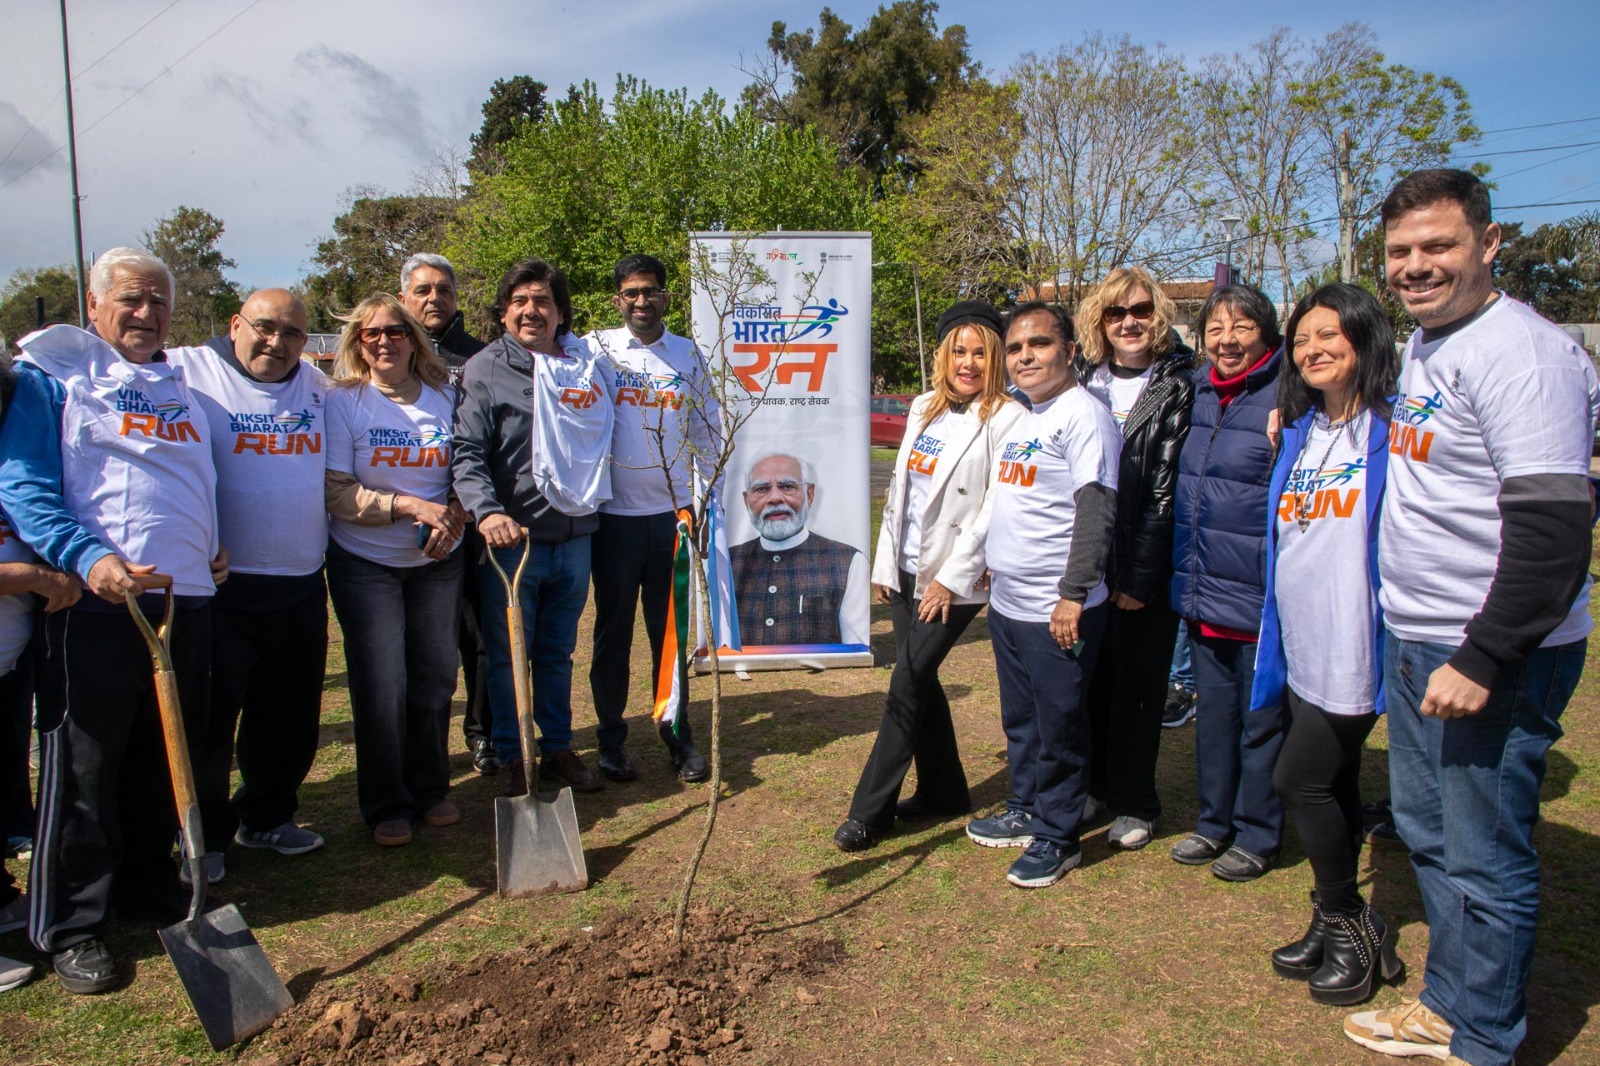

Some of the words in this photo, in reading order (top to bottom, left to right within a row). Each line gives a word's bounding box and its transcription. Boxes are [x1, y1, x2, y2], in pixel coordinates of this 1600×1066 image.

[732, 302, 782, 319] विकसित
[732, 321, 787, 343] भारत
[733, 343, 838, 392] रन
[615, 387, 685, 411] RUN
[808, 395, 830, 406] सेवक
[119, 412, 202, 443] RUN
[228, 413, 276, 424] VIKSIT
[230, 422, 290, 433] BHARAT
[233, 432, 321, 455] RUN
[369, 429, 411, 439] VIKSIT
[369, 437, 423, 447] BHARAT
[370, 446, 450, 468] RUN
[1278, 488, 1361, 522] RUN
